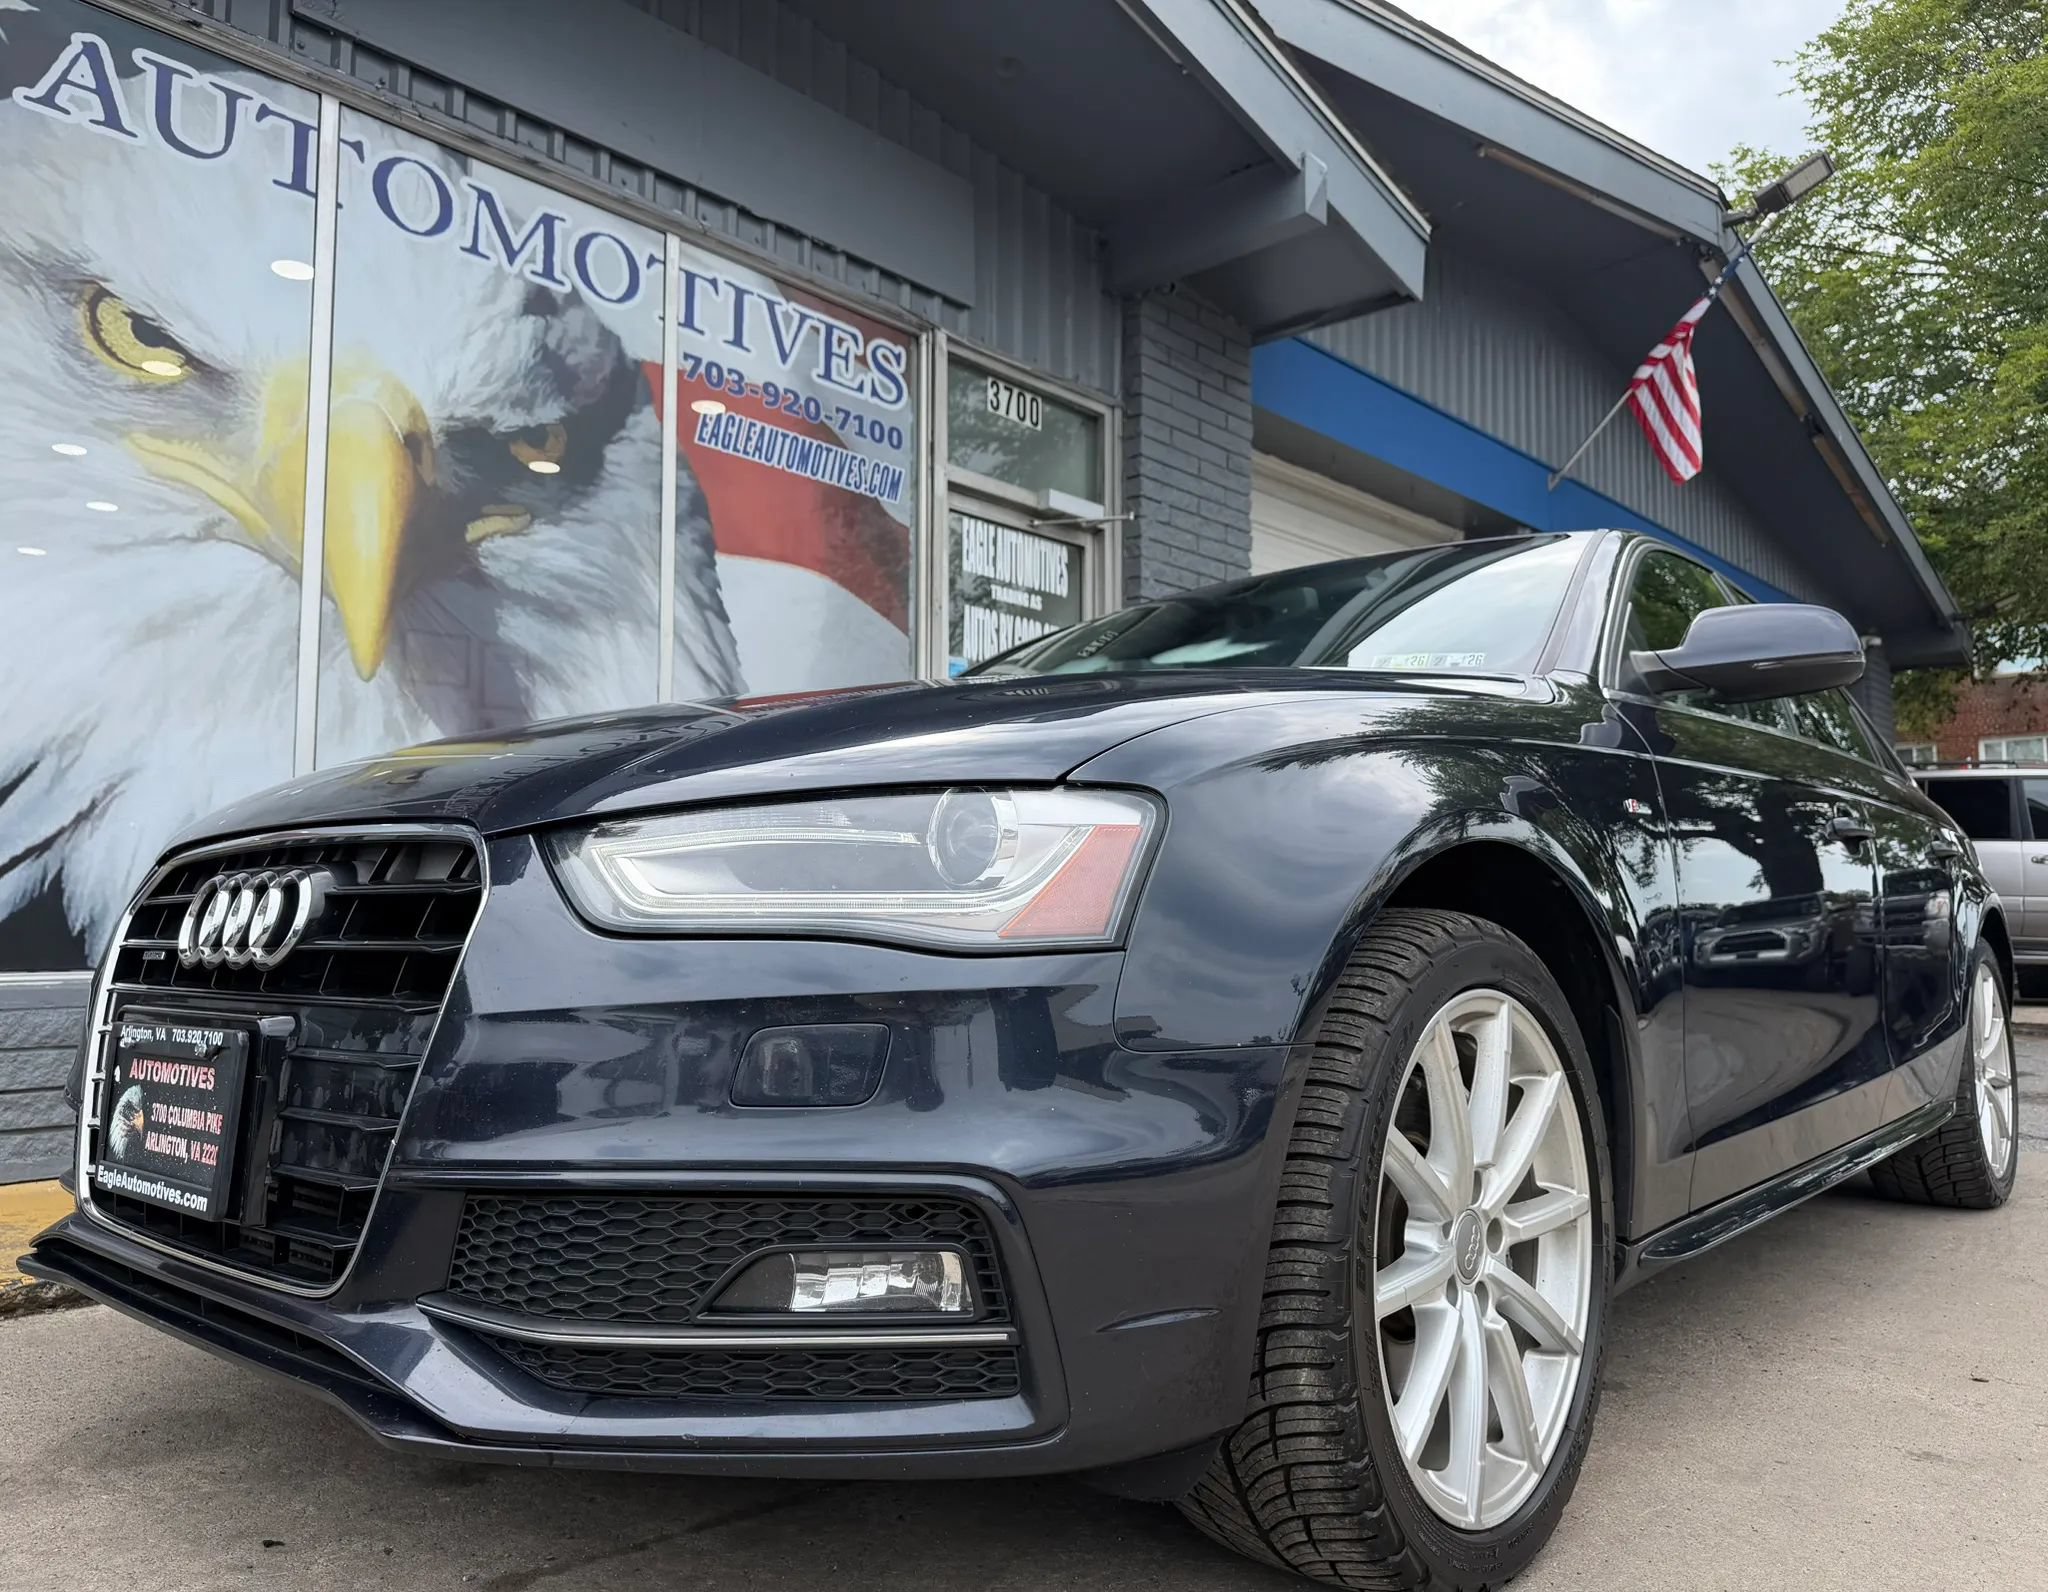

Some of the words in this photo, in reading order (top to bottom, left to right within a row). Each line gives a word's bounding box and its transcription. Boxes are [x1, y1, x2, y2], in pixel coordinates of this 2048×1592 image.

[20, 38, 907, 406] AUTOMOTIVES
[682, 352, 904, 450] 703-920-7100
[988, 380, 1041, 428] 3700
[696, 411, 904, 501] EAGLEAUTOMOTIVES.COM
[961, 517, 996, 579] EAGLE
[996, 526, 1069, 599] AUTOMOTIVES
[963, 604, 999, 662] AUTOS
[120, 1025, 154, 1042] Arlington,
[156, 1027, 167, 1041] VA
[172, 1028, 224, 1046] 703.920.7100
[129, 1058, 216, 1091] AUTOMOTIVES
[151, 1102, 168, 1124] 3700
[168, 1105, 205, 1131] COLUMBIA
[206, 1111, 224, 1136] PIKE
[145, 1131, 189, 1164] ARLINGTON,
[190, 1140, 201, 1162] VA
[97, 1165, 208, 1212] EagleAutomotives.com
